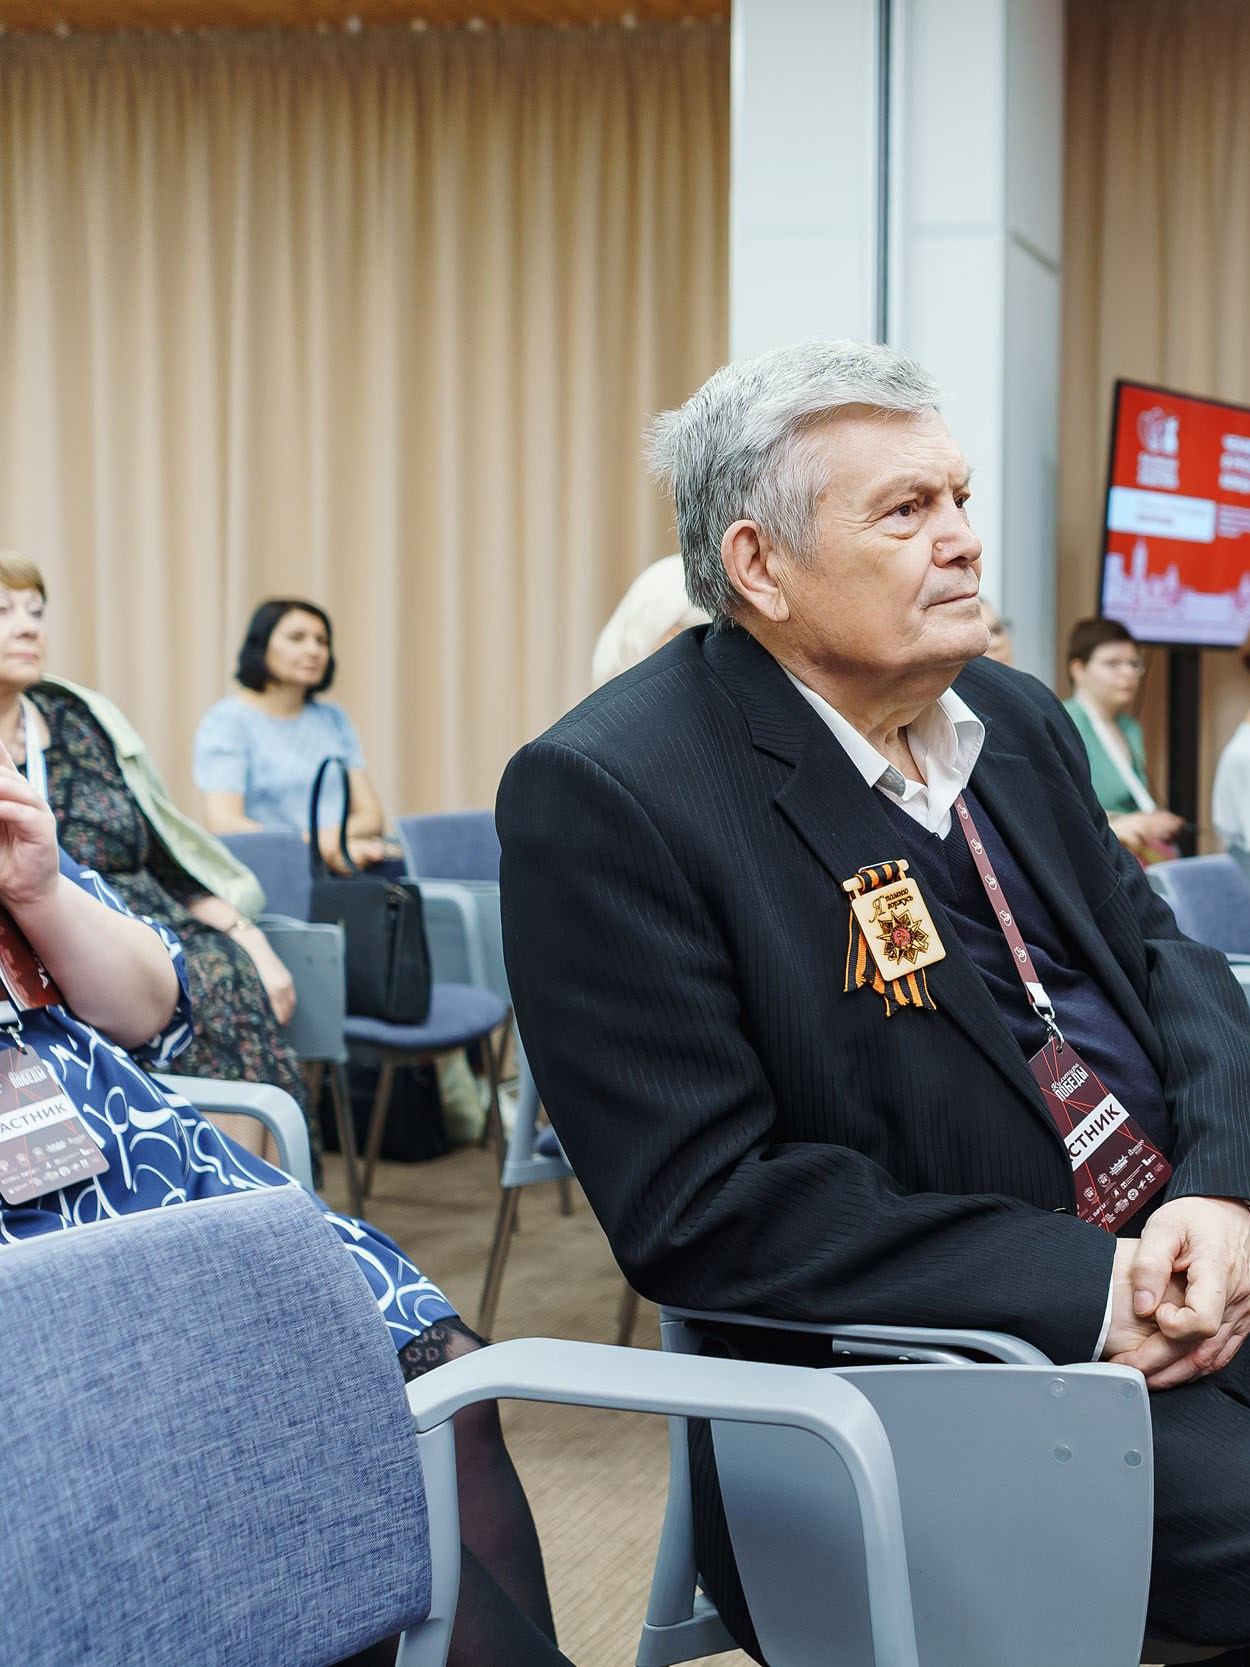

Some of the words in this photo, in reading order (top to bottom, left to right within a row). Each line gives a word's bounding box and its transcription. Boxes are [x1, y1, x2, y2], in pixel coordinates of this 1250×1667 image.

[868, 895, 886, 924] Я
[1054, 1066, 1090, 1102] ПОБЕДЫ
[1069, 1102, 1120, 1159] СТНИК
